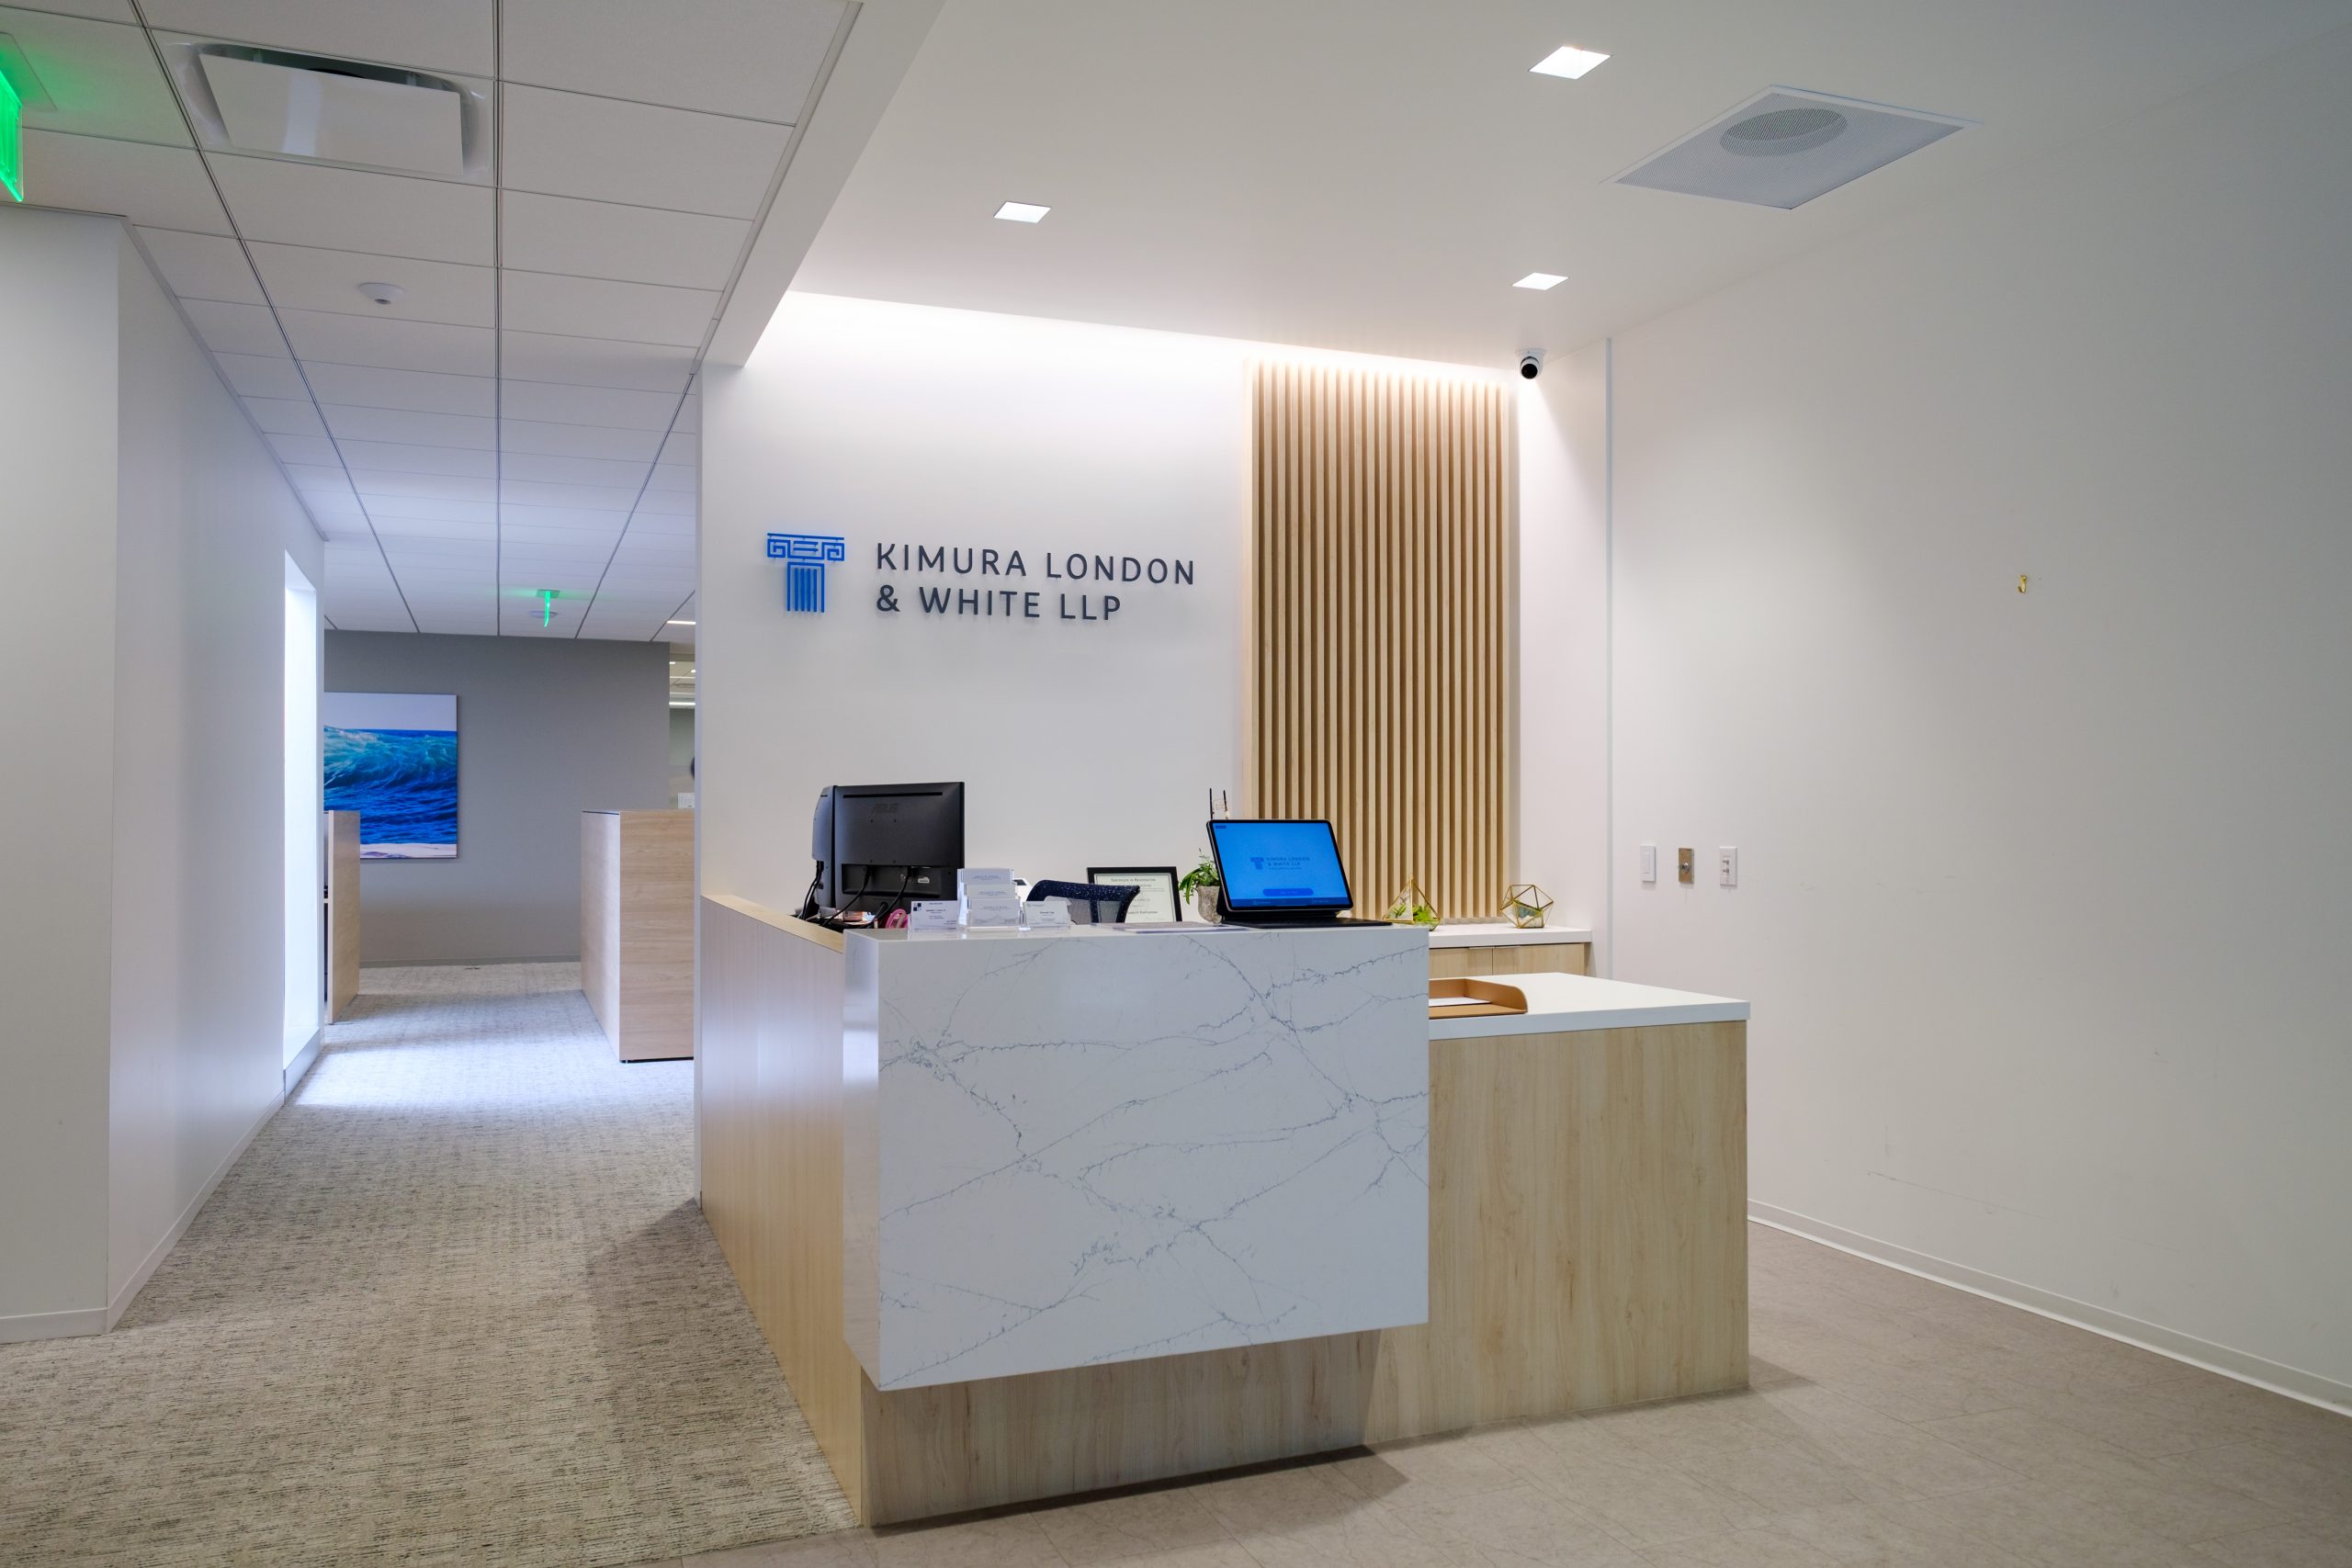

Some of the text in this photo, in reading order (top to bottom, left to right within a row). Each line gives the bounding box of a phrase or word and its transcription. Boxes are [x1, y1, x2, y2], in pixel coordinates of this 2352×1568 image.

[876, 542, 1194, 585] KIMURA LONDON
[876, 584, 1122, 621] & WHITE LLP
